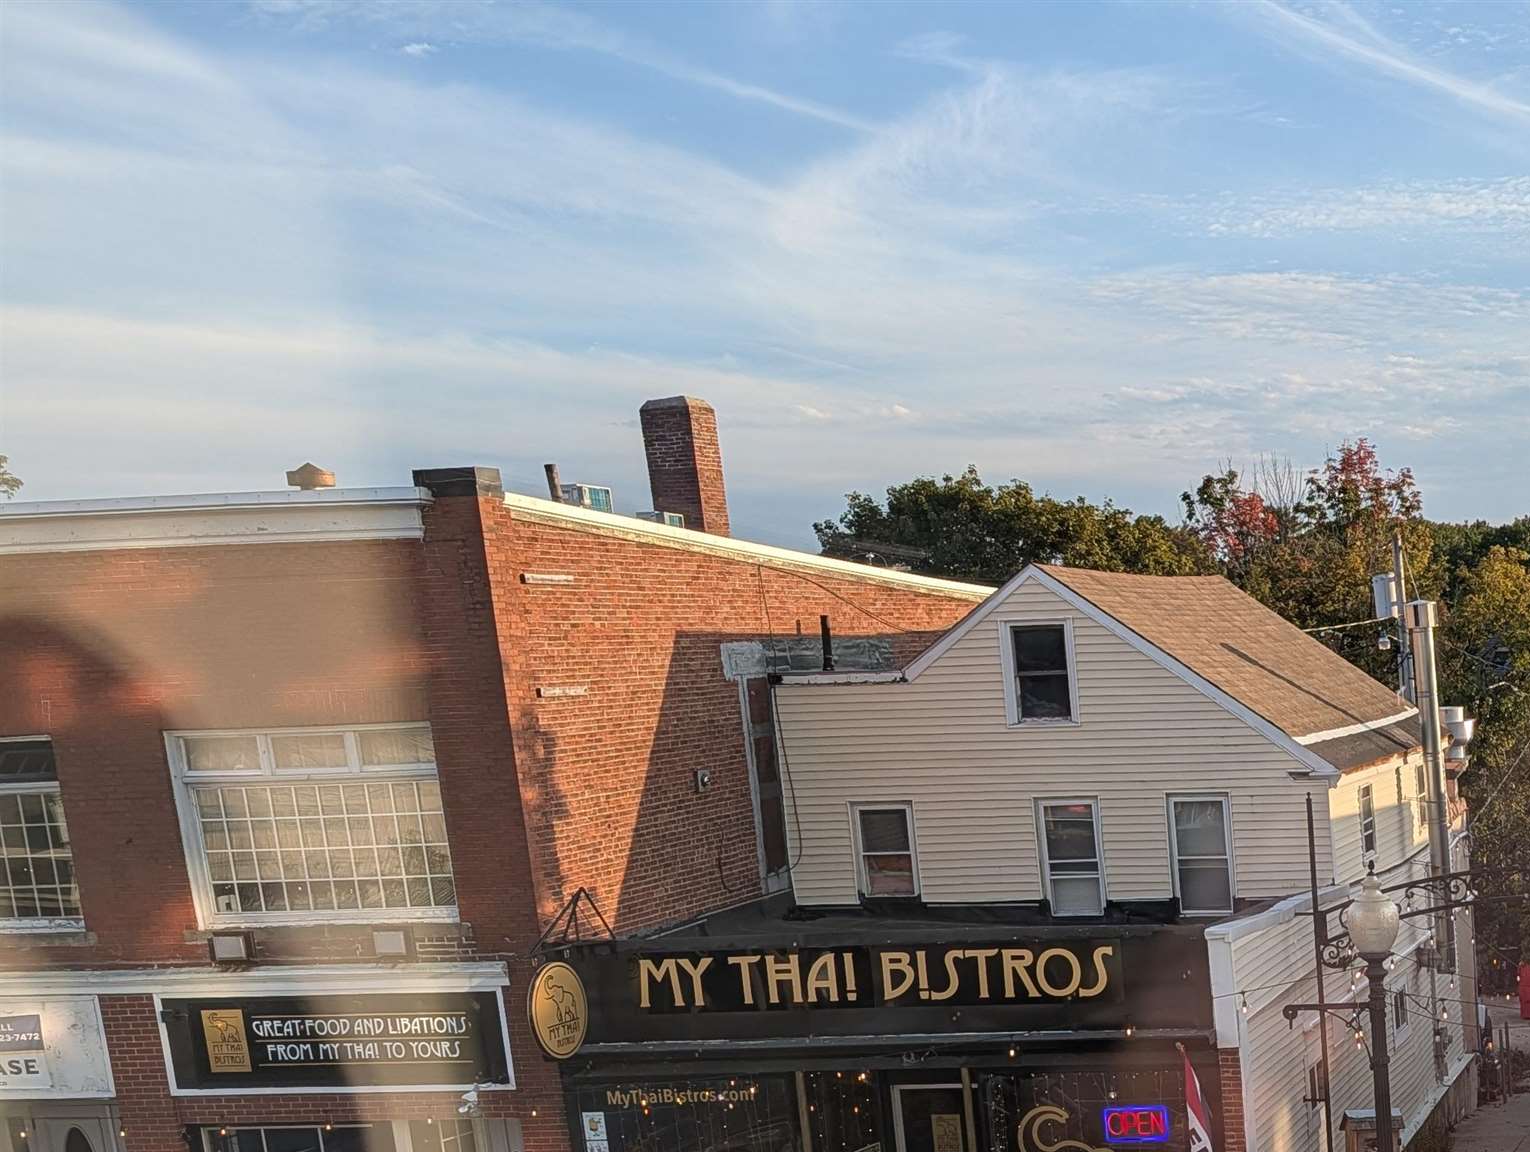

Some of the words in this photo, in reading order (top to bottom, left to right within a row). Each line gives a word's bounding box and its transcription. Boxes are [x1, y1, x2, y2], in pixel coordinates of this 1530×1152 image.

[638, 957, 714, 1008] MY
[879, 946, 1113, 1001] BISTROS
[252, 1020, 302, 1037] GREAT
[306, 1019, 350, 1036] FOOD
[354, 1018, 384, 1036] AND
[387, 1016, 467, 1035] LIBATIONS
[266, 1043, 314, 1061] FROM
[319, 1042, 340, 1060] MY
[382, 1042, 406, 1059] TO
[409, 1041, 461, 1059] YOURS
[606, 1086, 756, 1109] MyThaiBistros.com
[1107, 1111, 1165, 1136] OPEN
